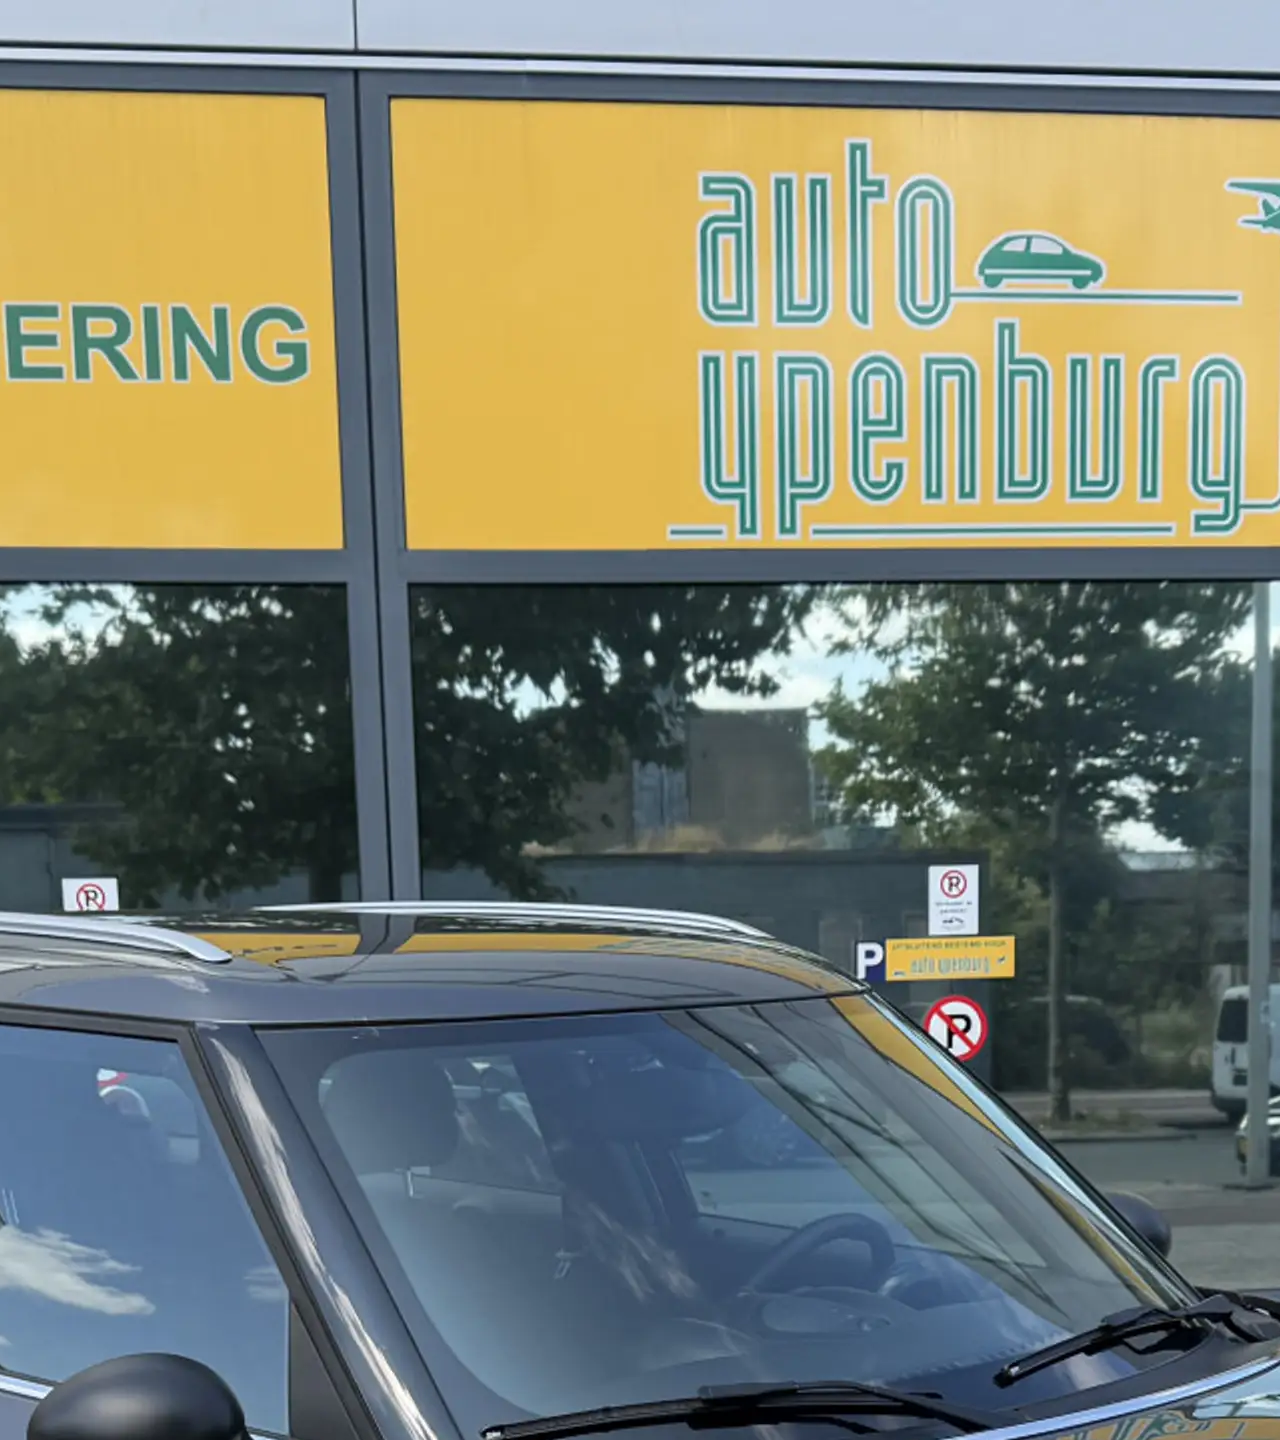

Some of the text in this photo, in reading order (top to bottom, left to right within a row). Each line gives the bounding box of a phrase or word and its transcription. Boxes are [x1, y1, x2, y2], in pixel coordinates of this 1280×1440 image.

[697, 138, 954, 329] auto
[697, 318, 1246, 539] ypenburg
[856, 942, 884, 979] P
